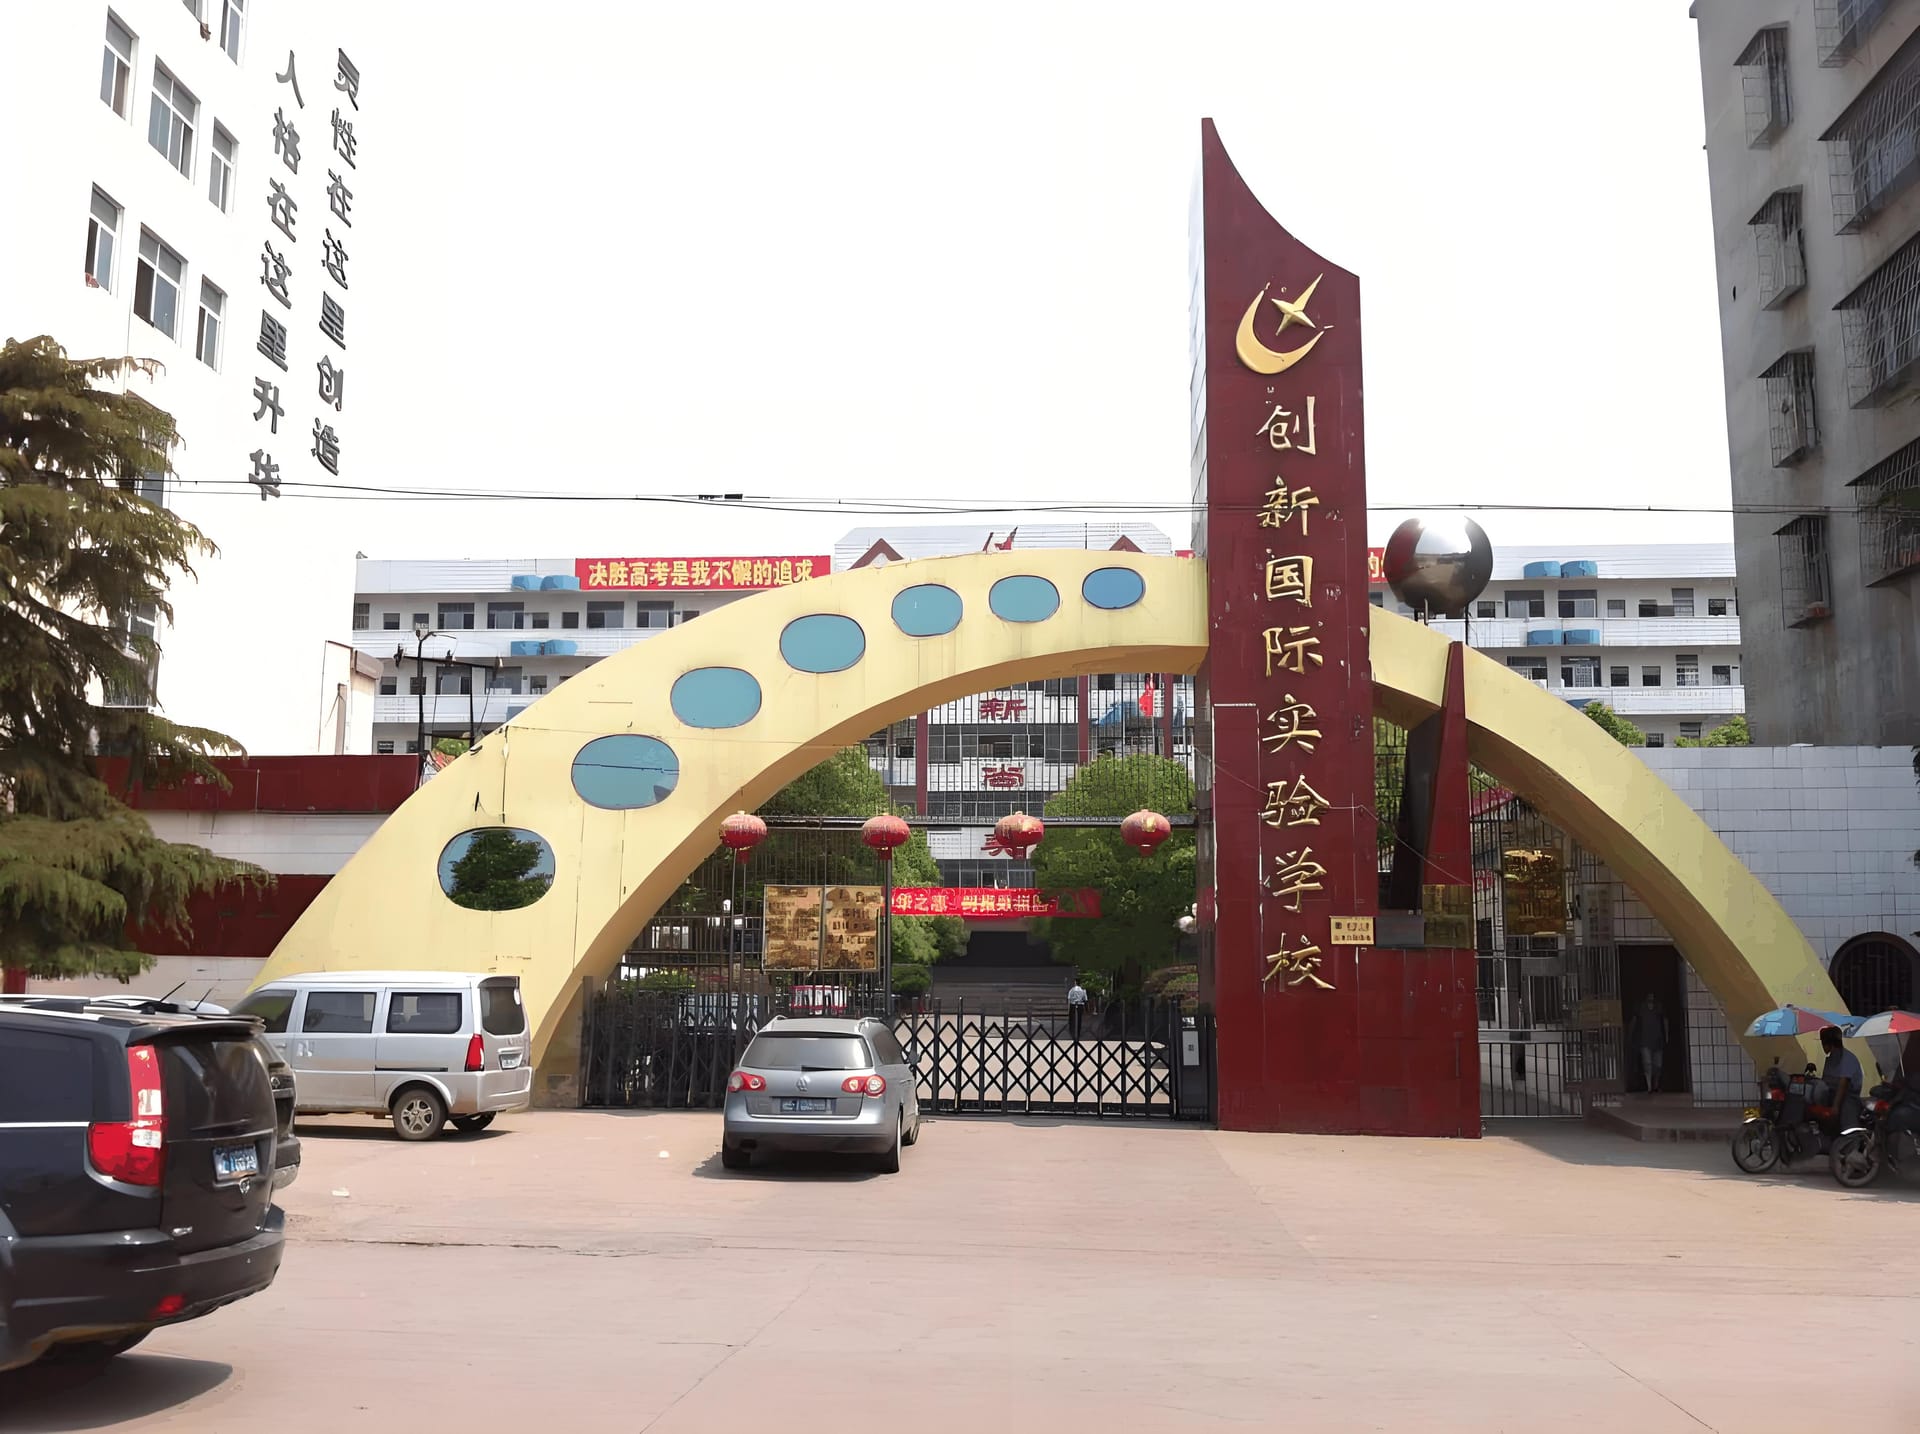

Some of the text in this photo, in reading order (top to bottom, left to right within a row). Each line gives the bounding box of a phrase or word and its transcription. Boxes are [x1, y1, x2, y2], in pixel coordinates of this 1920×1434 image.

[248, 50, 305, 501] 人格在这里升华
[311, 48, 361, 476] 灵性在这里创造
[588, 559, 814, 588] 决胜高考是我不懈的追求
[1256, 395, 1336, 993] 创新国际实验学校
